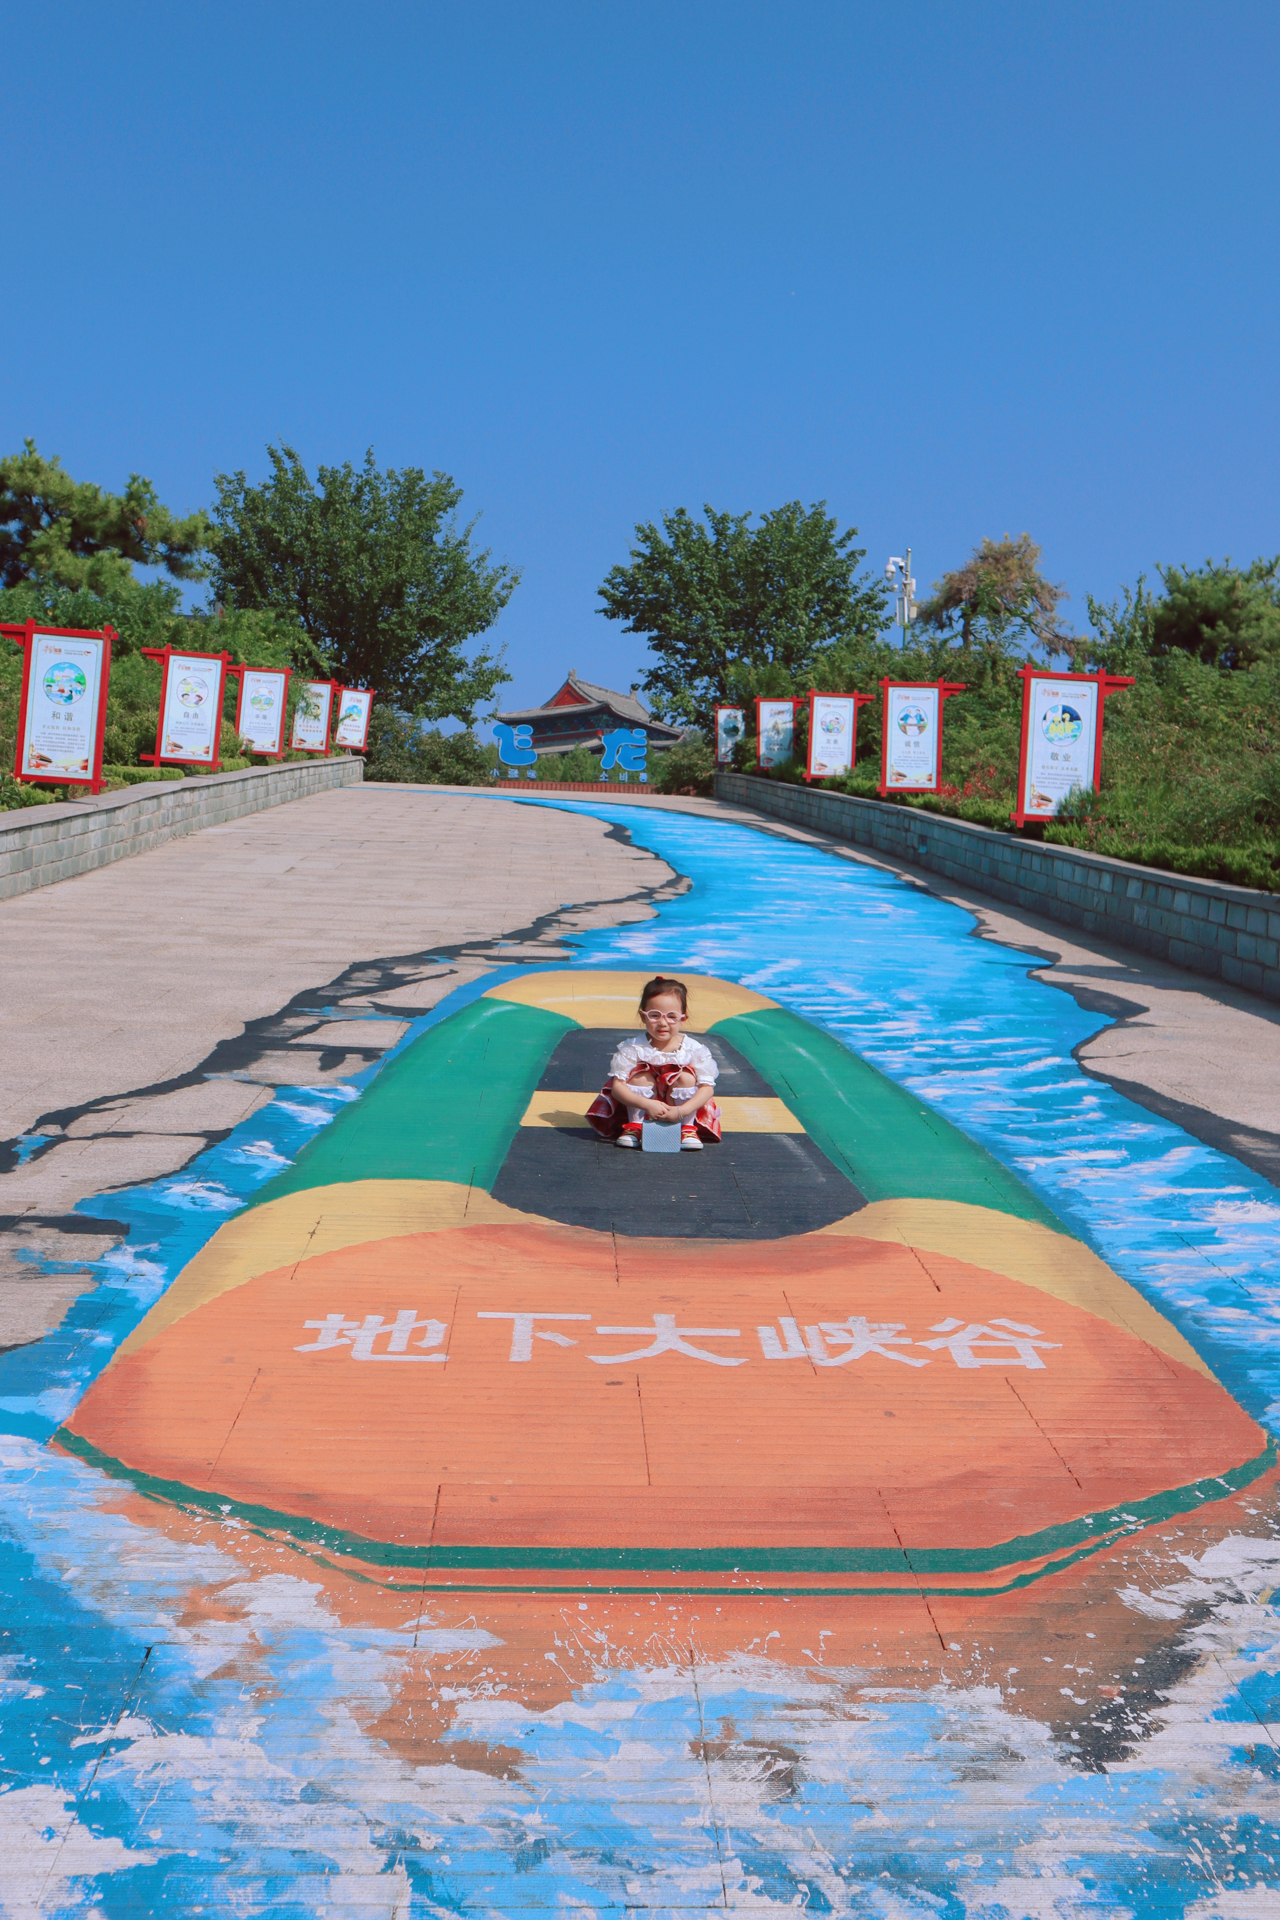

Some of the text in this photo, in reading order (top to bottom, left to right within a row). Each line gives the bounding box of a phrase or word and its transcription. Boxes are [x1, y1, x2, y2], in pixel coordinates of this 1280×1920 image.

[51, 711, 74, 721] 和谐
[183, 711, 199, 719] 自由
[1051, 752, 1071, 762] 敬业
[293, 1309, 1063, 1369] 地下大峡谷
